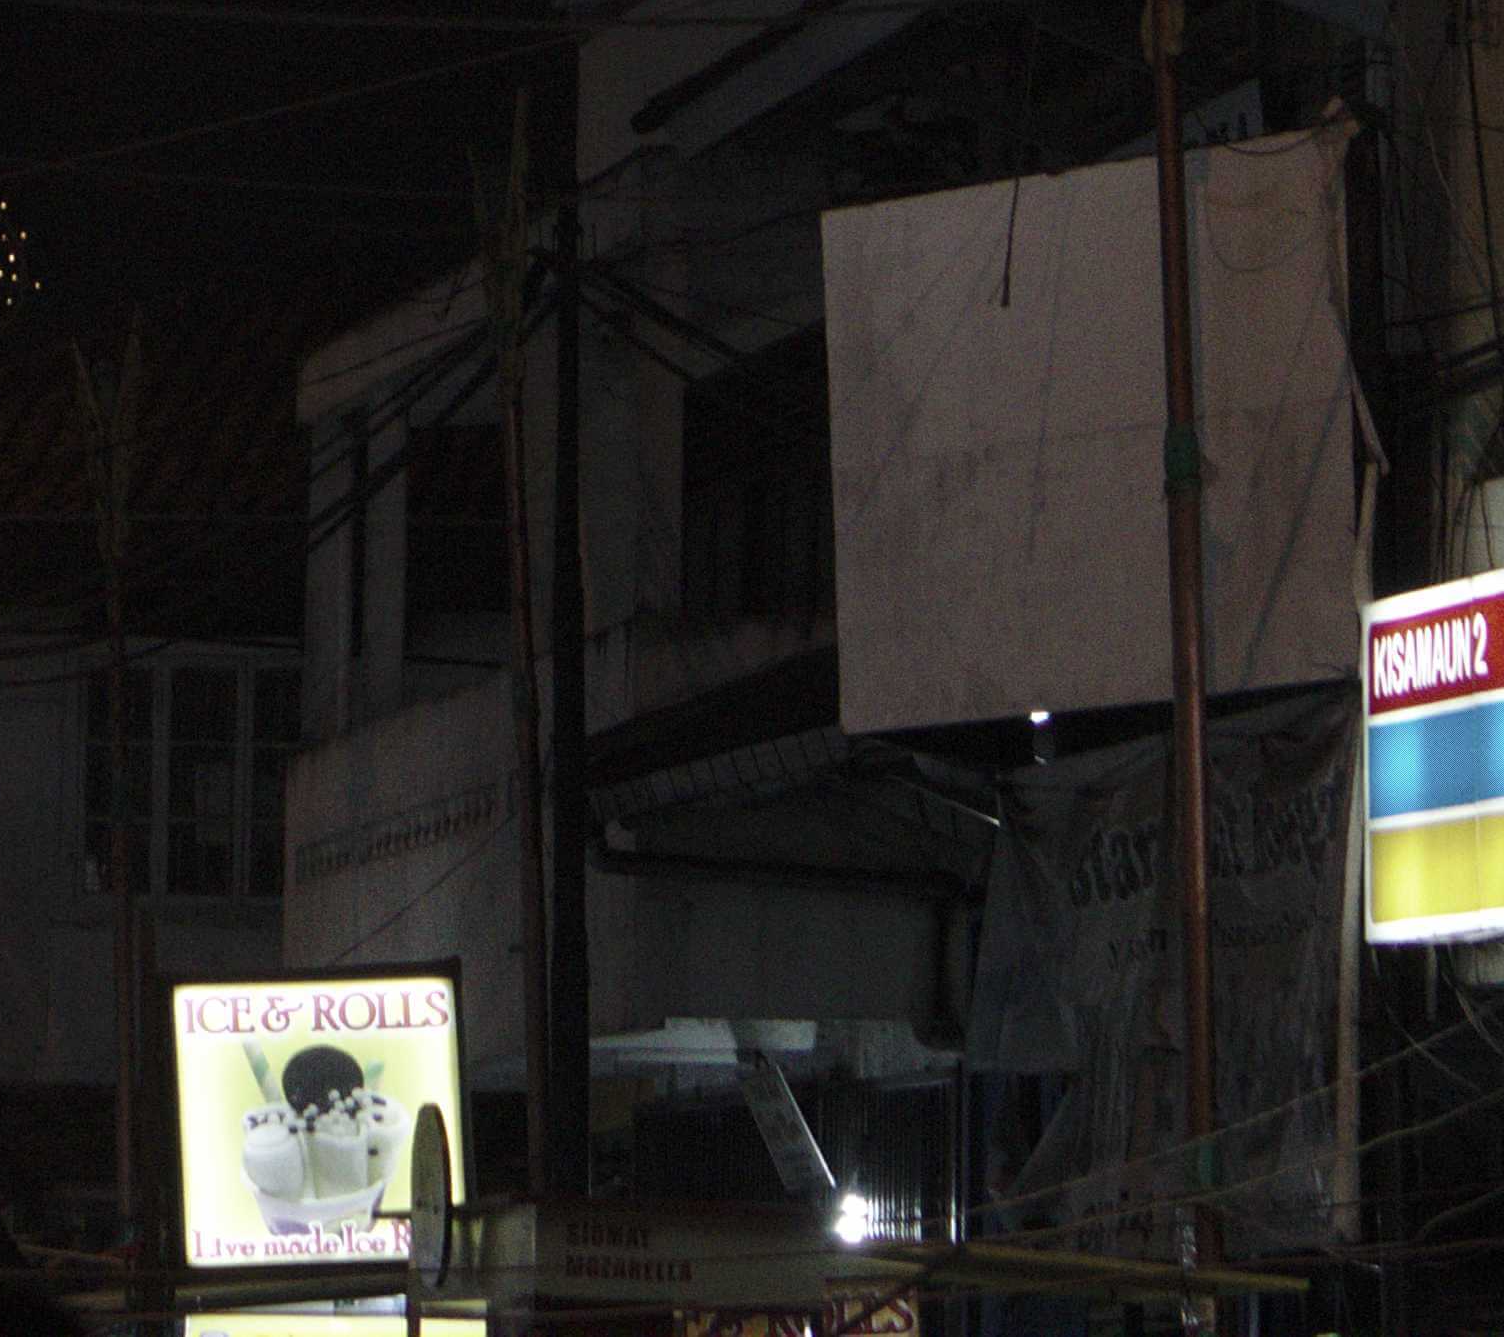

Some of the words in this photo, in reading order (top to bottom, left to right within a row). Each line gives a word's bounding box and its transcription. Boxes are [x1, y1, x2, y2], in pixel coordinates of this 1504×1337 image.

[1373, 615, 1472, 700] KISAMAUN
[1472, 611, 1490, 676] 2
[183, 996, 256, 1034] ICE
[260, 995, 305, 1034] &
[311, 990, 450, 1032] ROLLS
[262, 1225, 339, 1257] made
[340, 1225, 388, 1254] Ice
